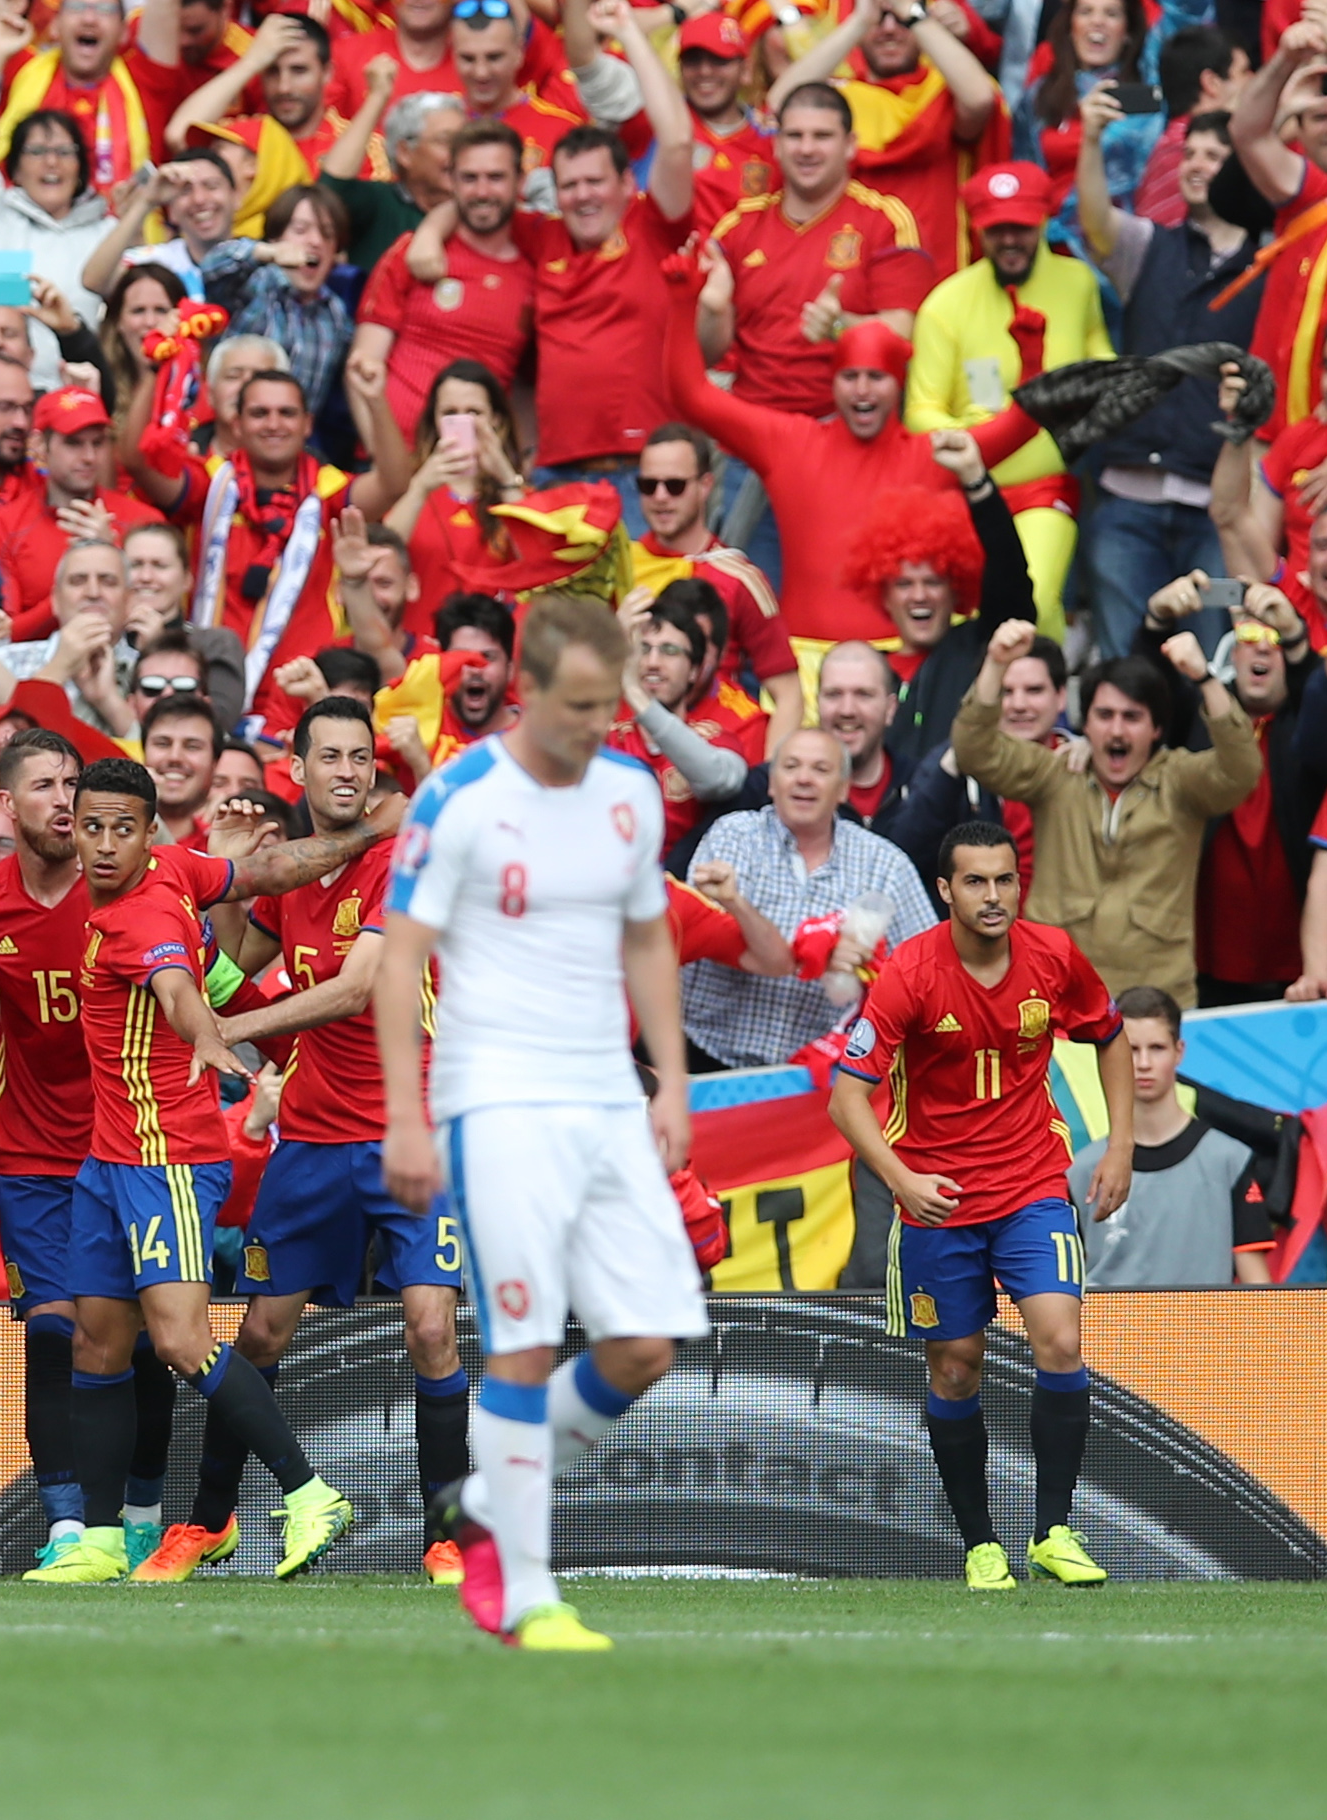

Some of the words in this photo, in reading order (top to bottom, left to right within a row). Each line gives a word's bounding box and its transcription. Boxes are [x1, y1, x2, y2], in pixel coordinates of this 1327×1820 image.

[500, 864, 527, 918] 8
[32, 970, 78, 1023] 15
[974, 1048, 1002, 1100] 11
[128, 1214, 171, 1277] 14
[434, 1216, 462, 1273] 5
[1050, 1230, 1081, 1286] 11
